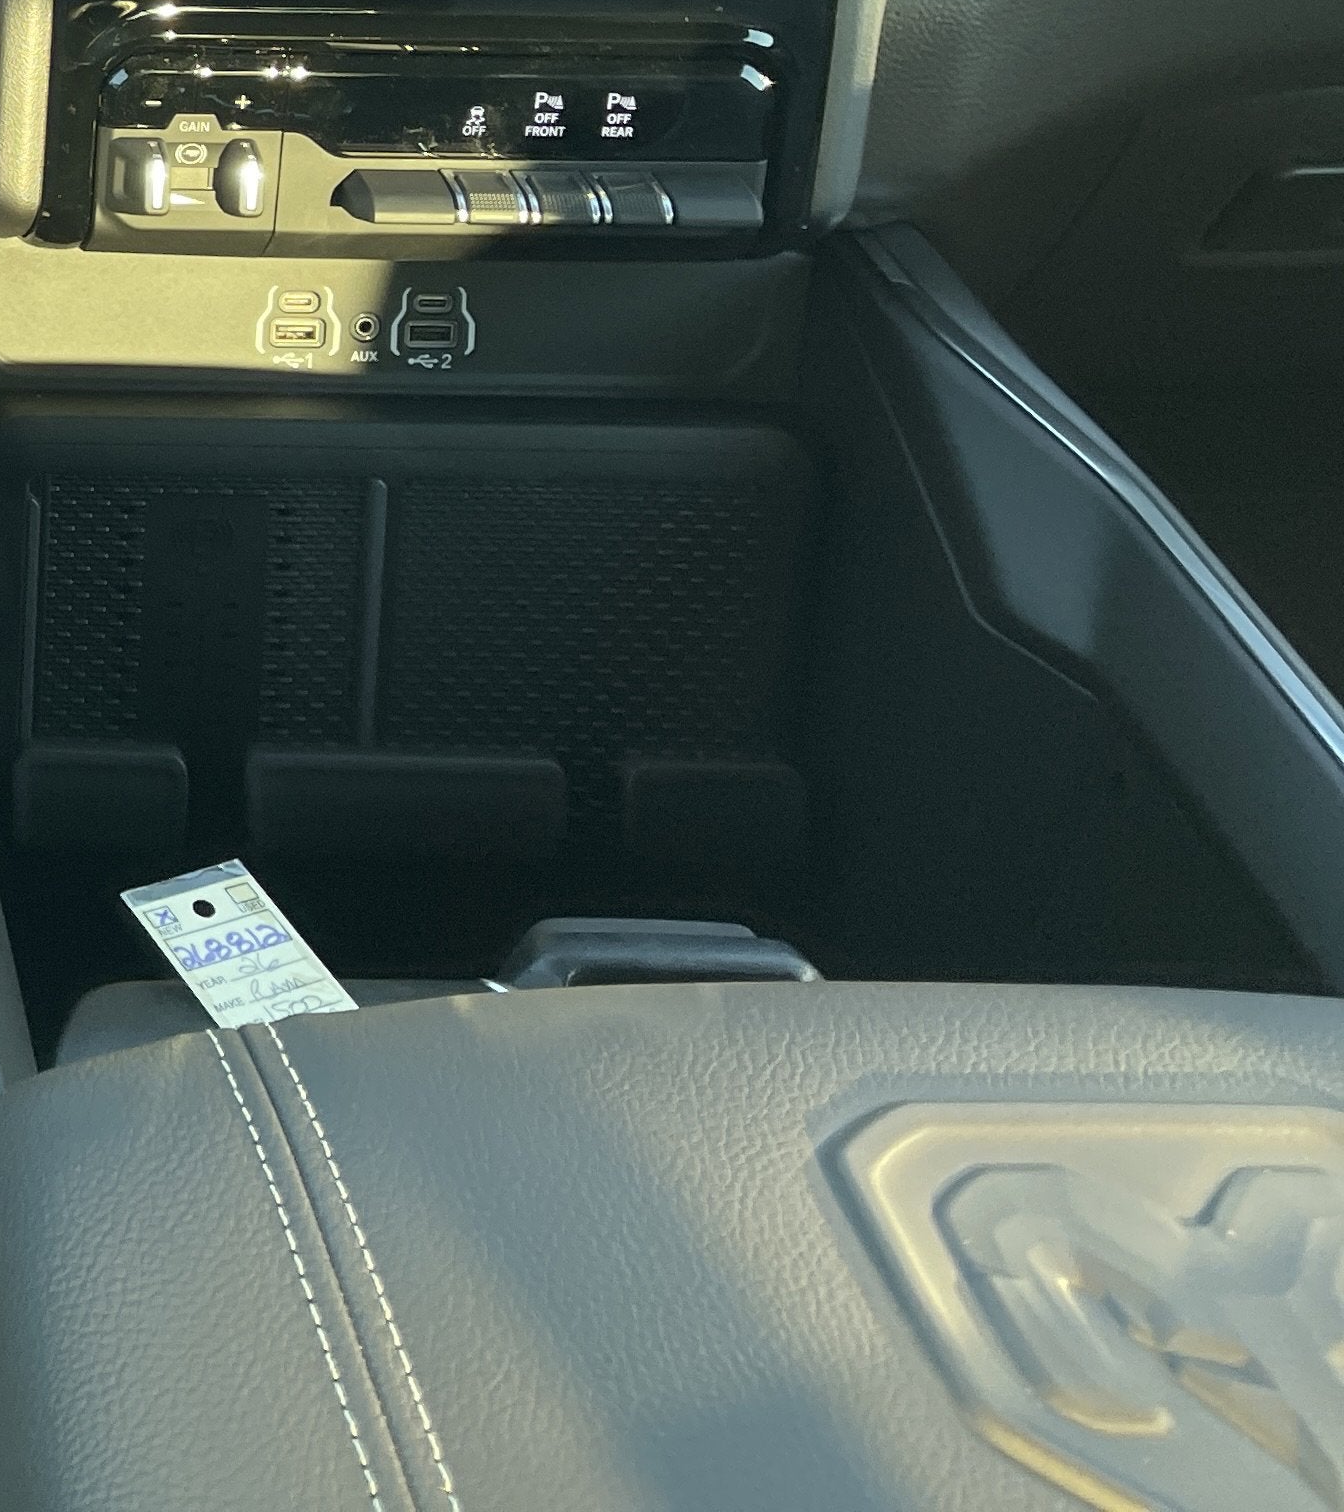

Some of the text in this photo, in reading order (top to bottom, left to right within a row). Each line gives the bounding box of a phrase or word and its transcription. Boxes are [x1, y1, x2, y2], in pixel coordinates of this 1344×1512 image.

[534, 112, 560, 124] OFF
[606, 113, 632, 125] OFF
[179, 120, 211, 133] GAIN
[462, 125, 487, 136] OFF
[525, 125, 566, 137] FRONT
[601, 126, 634, 138] REAR
[350, 351, 379, 363] AUX
[238, 899, 266, 914] USED
[159, 923, 183, 938] NEW
[173, 923, 288, 972] 268812
[198, 952, 280, 991] YEAR 26
[214, 996, 247, 1014] MAKE
